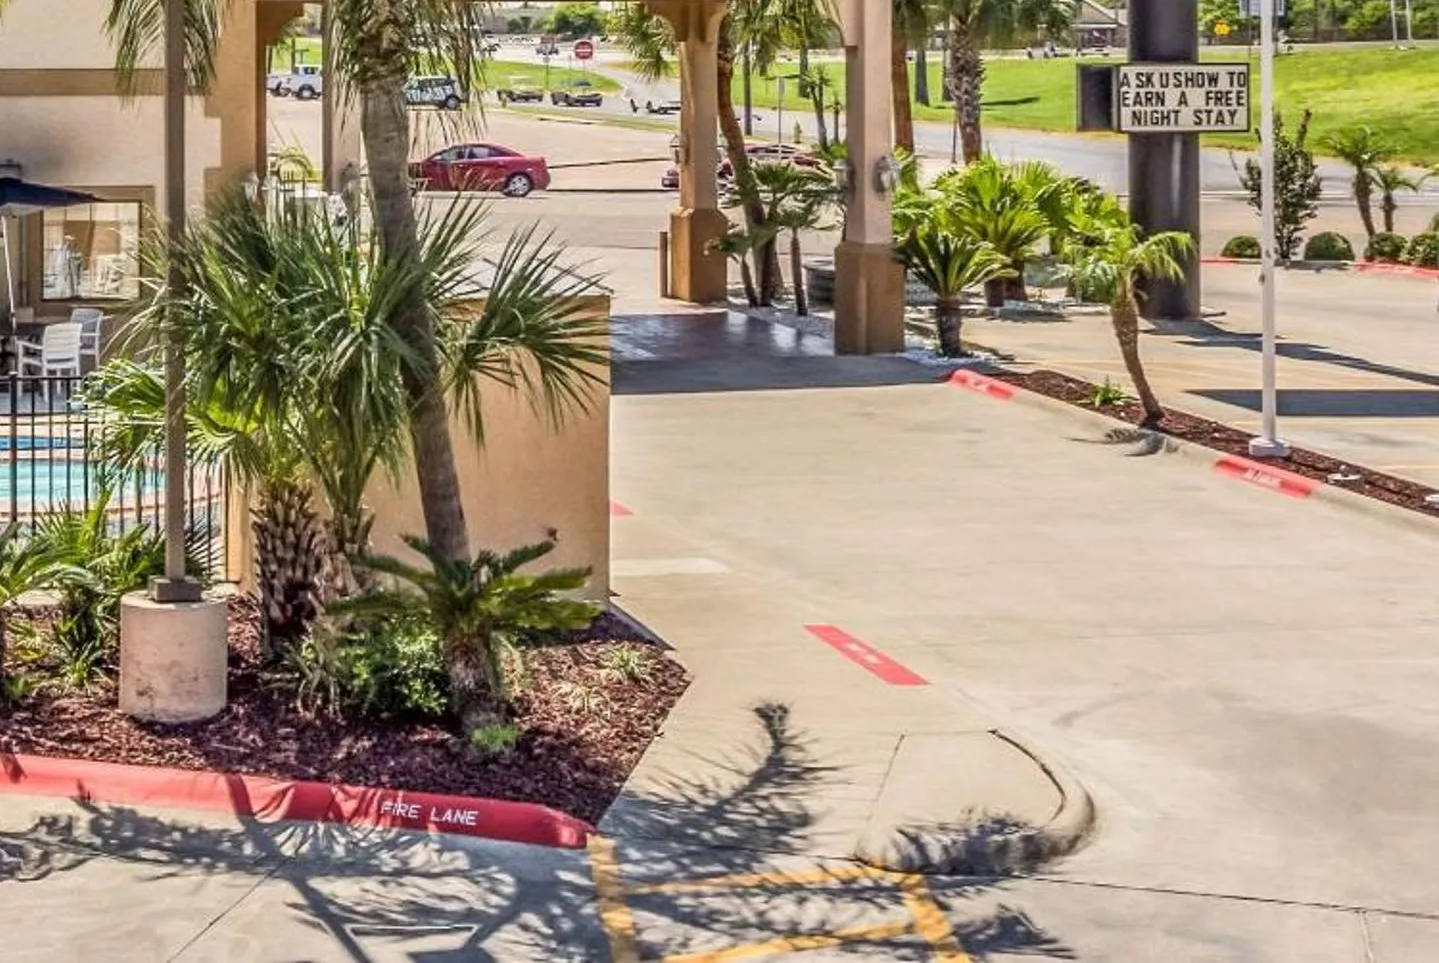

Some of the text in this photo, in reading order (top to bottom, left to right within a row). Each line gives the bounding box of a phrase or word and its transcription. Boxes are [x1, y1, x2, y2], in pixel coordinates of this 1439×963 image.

[1120, 72, 1155, 88] ASK
[1227, 72, 1248, 88] TO
[1121, 90, 1246, 107] EARN A FREE
[1131, 109, 1239, 126] NIGHT STAY
[380, 801, 480, 826] FIRE LANE
